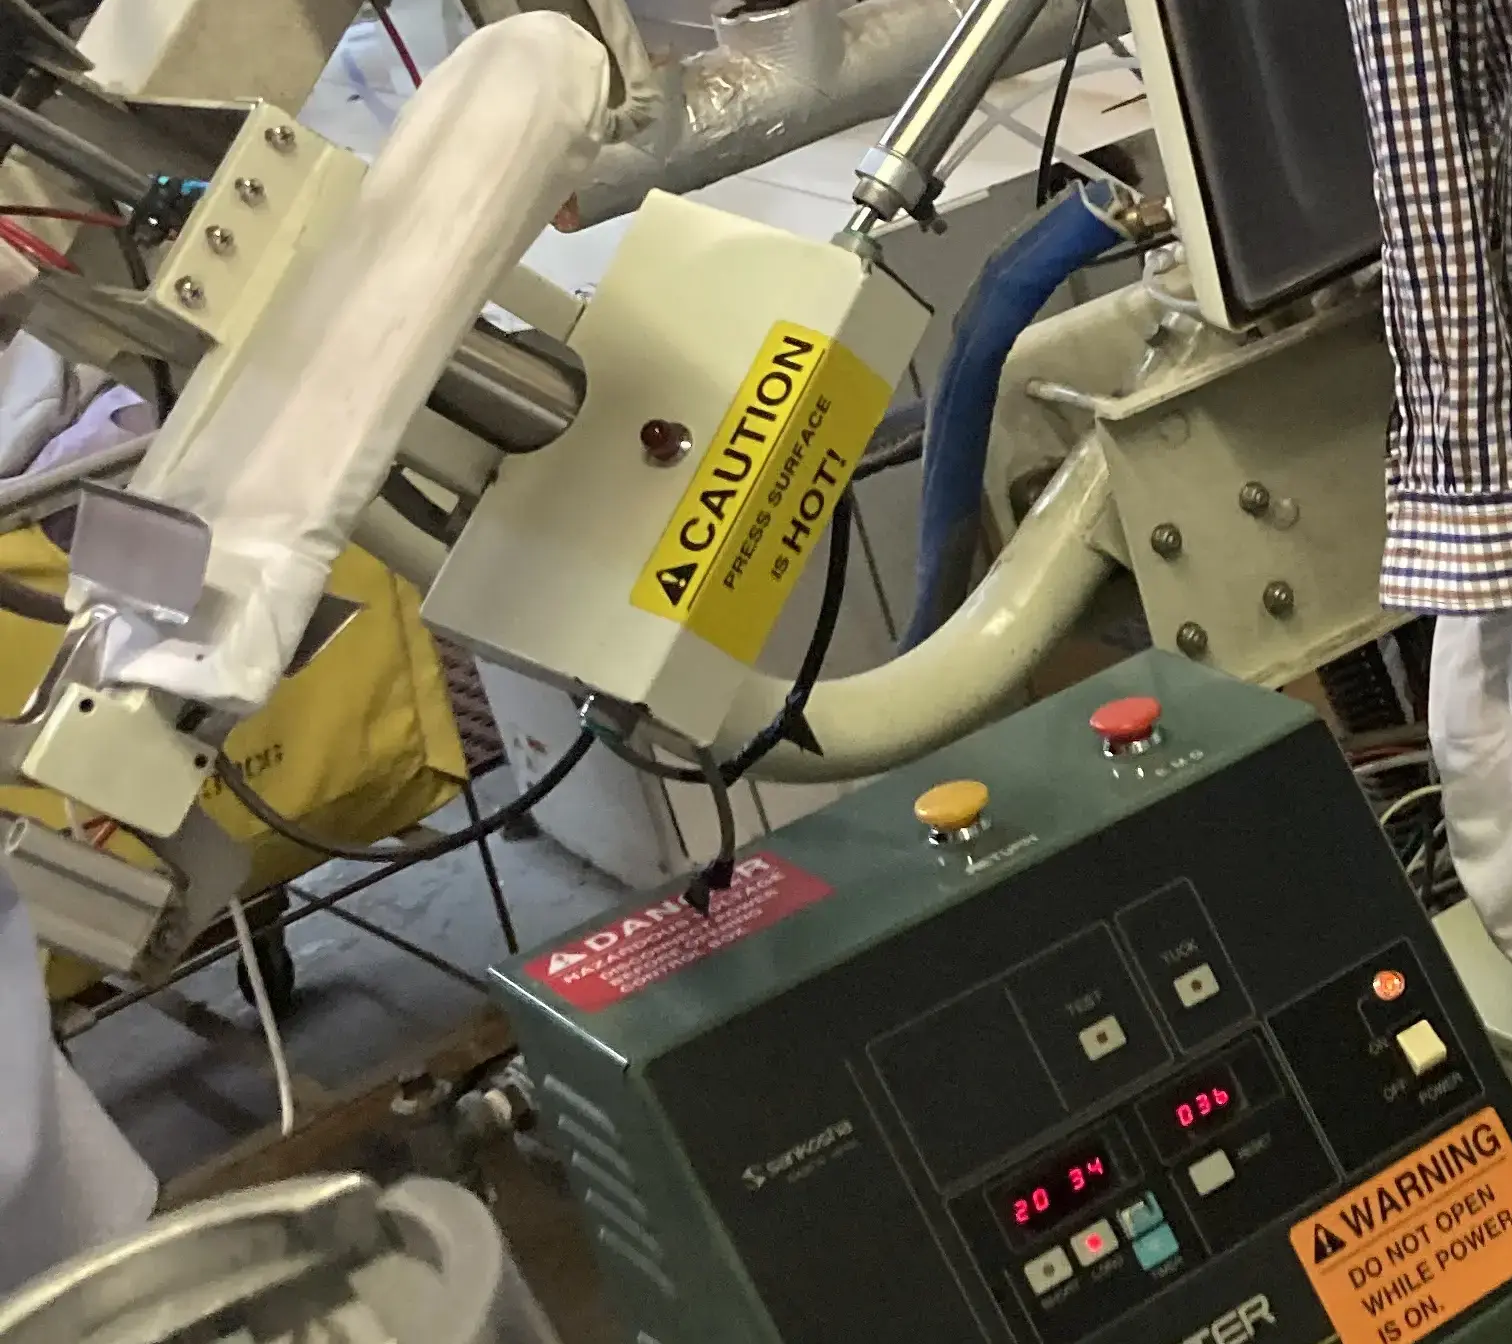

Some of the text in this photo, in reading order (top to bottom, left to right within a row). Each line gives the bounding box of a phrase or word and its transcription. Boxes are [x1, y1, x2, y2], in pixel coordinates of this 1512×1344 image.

[680, 335, 814, 552] CAUTION
[723, 394, 832, 591] PRESS SURFACE
[770, 448, 847, 582] IS HOT!
[583, 857, 770, 952] DANR
[1175, 1087, 1230, 1128] 036
[1418, 1070, 1464, 1105] POWER
[1013, 1156, 1104, 1225] 20 34
[1339, 1122, 1502, 1239] WARNING
[1347, 1183, 1497, 1291] DO NOT OPEN
[1360, 1260, 1436, 1318] WHILE
[1403, 1294, 1446, 1330] ON.
